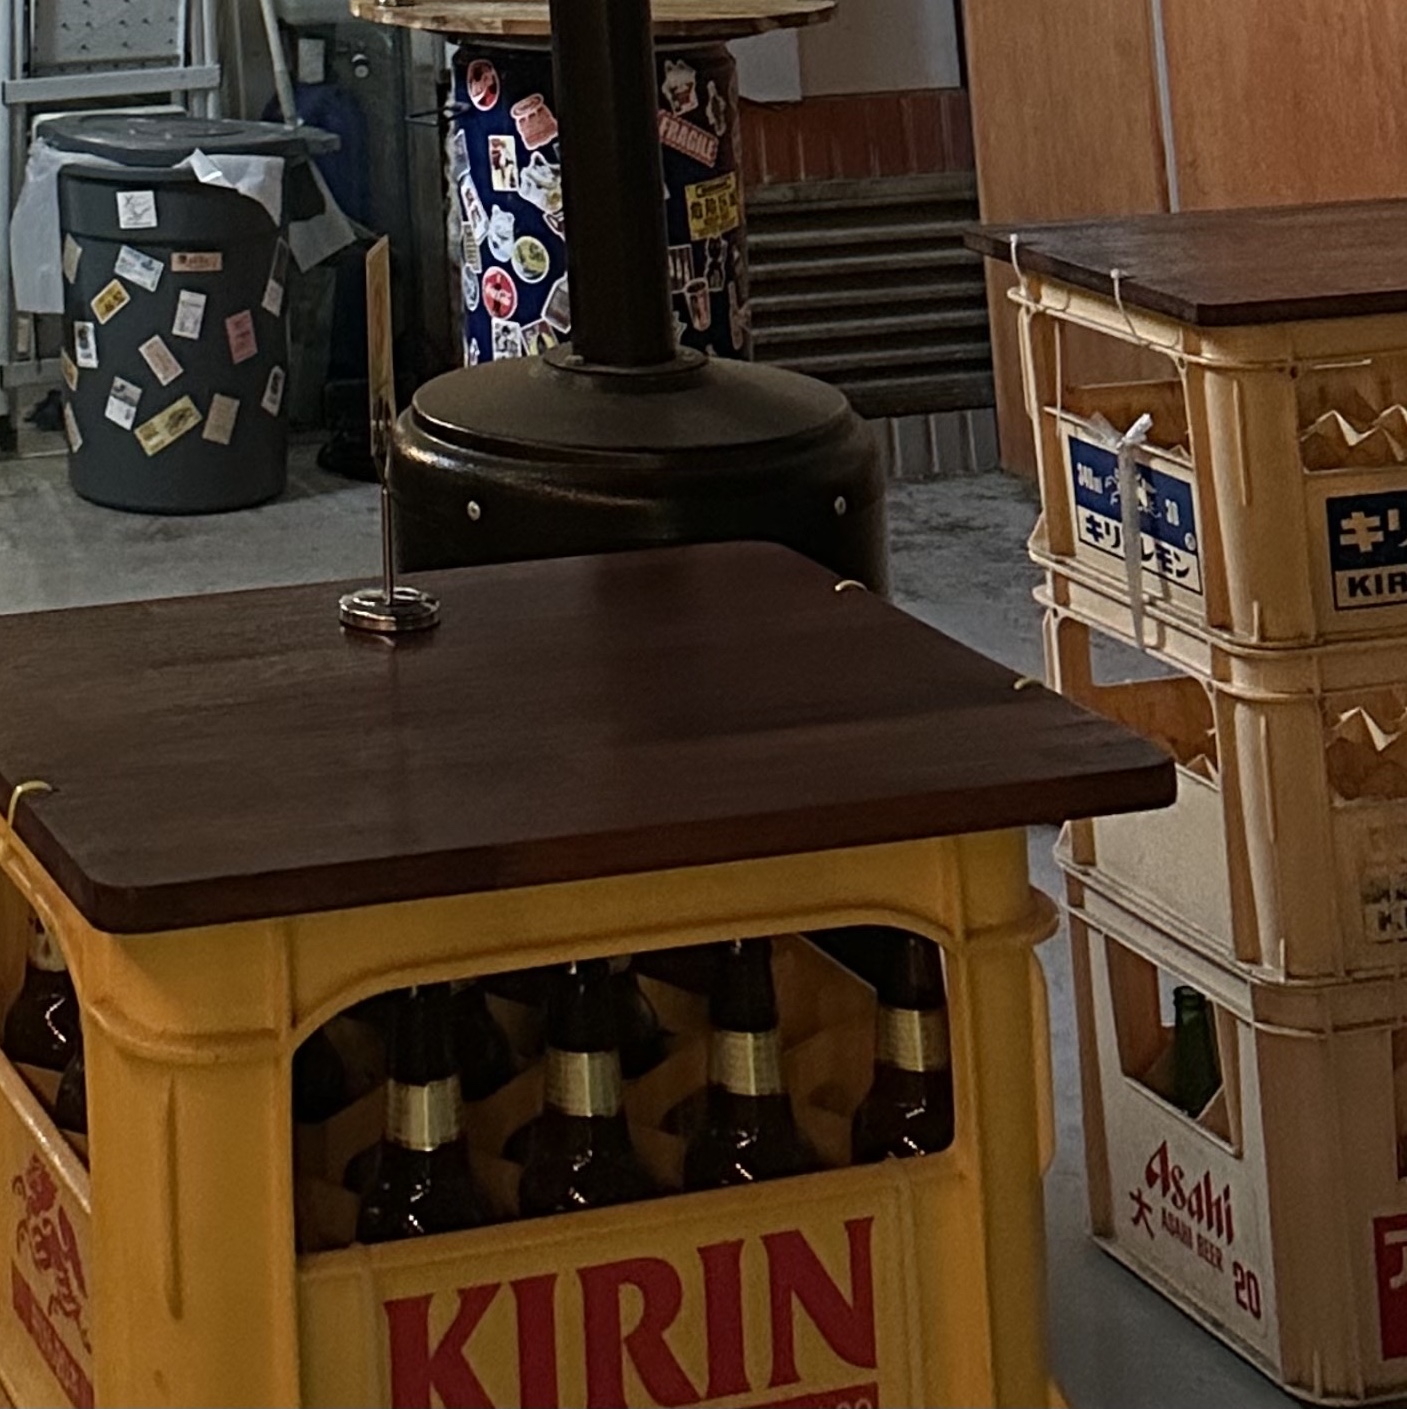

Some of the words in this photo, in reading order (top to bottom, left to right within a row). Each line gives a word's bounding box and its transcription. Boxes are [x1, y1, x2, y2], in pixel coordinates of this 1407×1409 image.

[659, 118, 717, 158] FRAGILE
[1086, 514, 1190, 579] キリレモン
[1145, 1140, 1234, 1246] Asahi
[384, 1216, 878, 1409] KIRIN
[1233, 1261, 1262, 1320] 20
